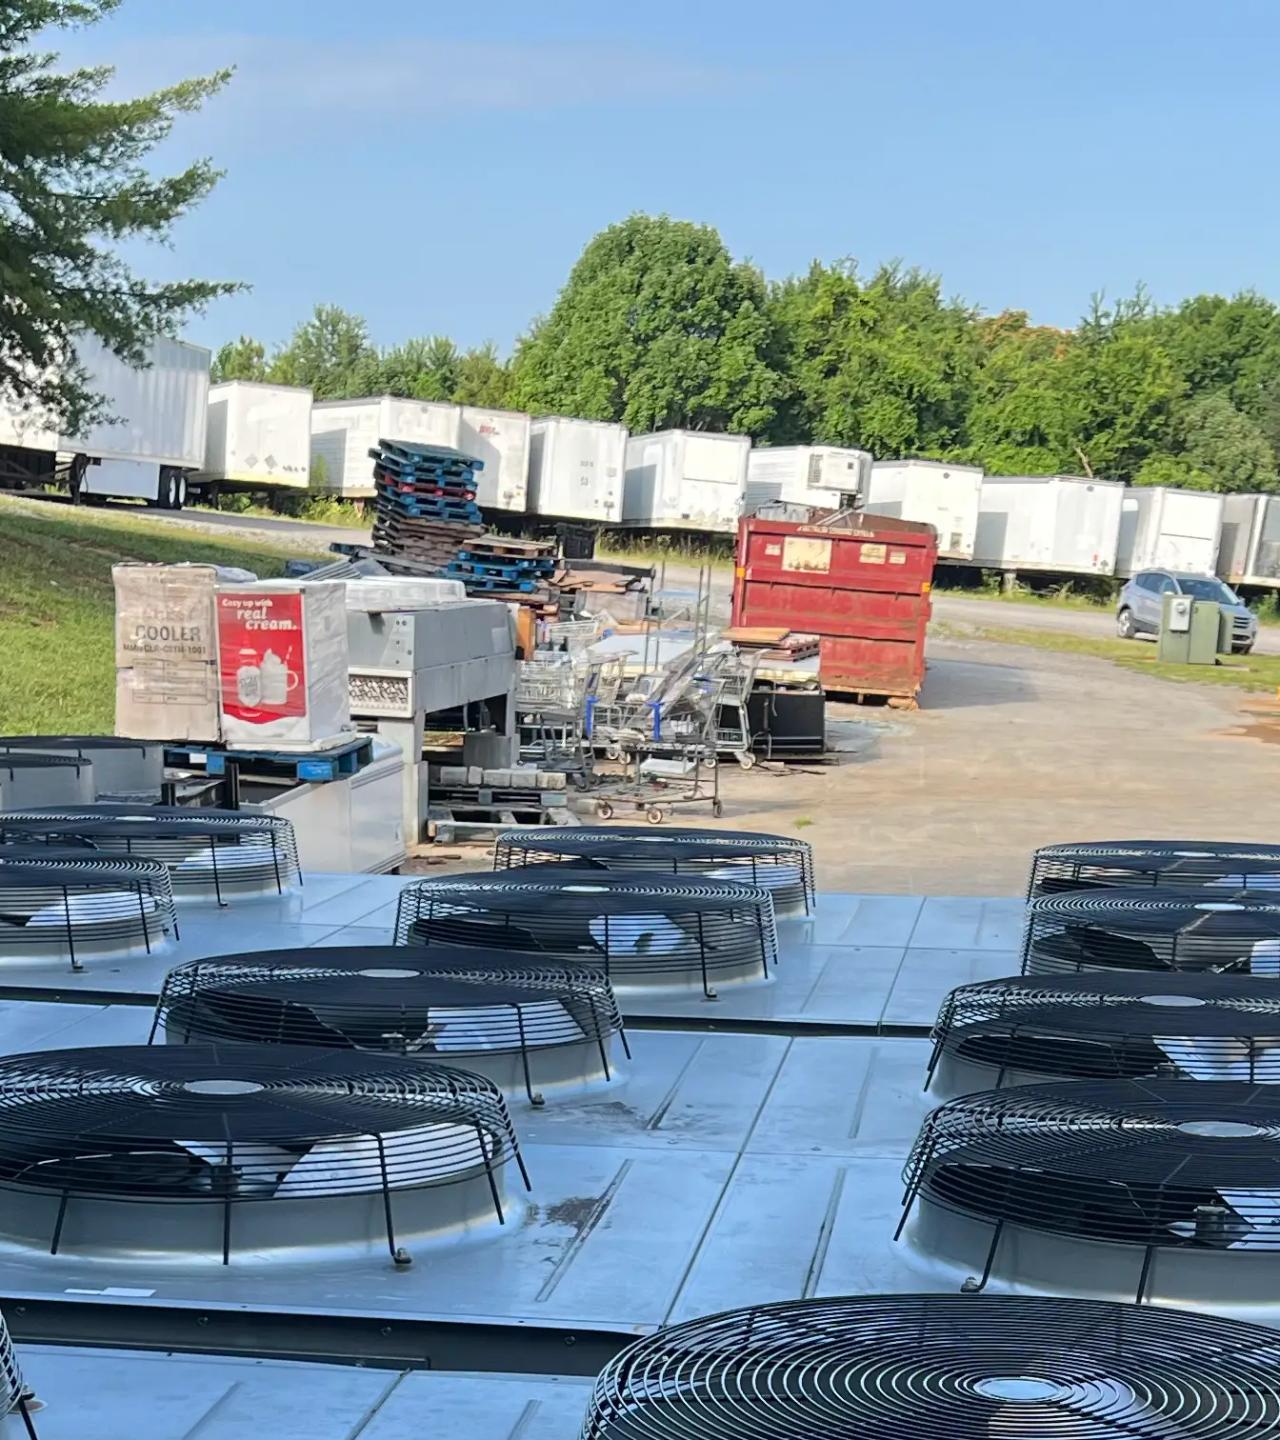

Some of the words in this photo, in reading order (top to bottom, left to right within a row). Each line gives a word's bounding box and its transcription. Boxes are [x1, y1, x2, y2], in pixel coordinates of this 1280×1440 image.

[242, 600, 254, 608] up
[254, 598, 273, 608] with
[237, 606, 267, 620] real
[245, 619, 297, 631] cream.
[136, 624, 201, 642] COOLER
